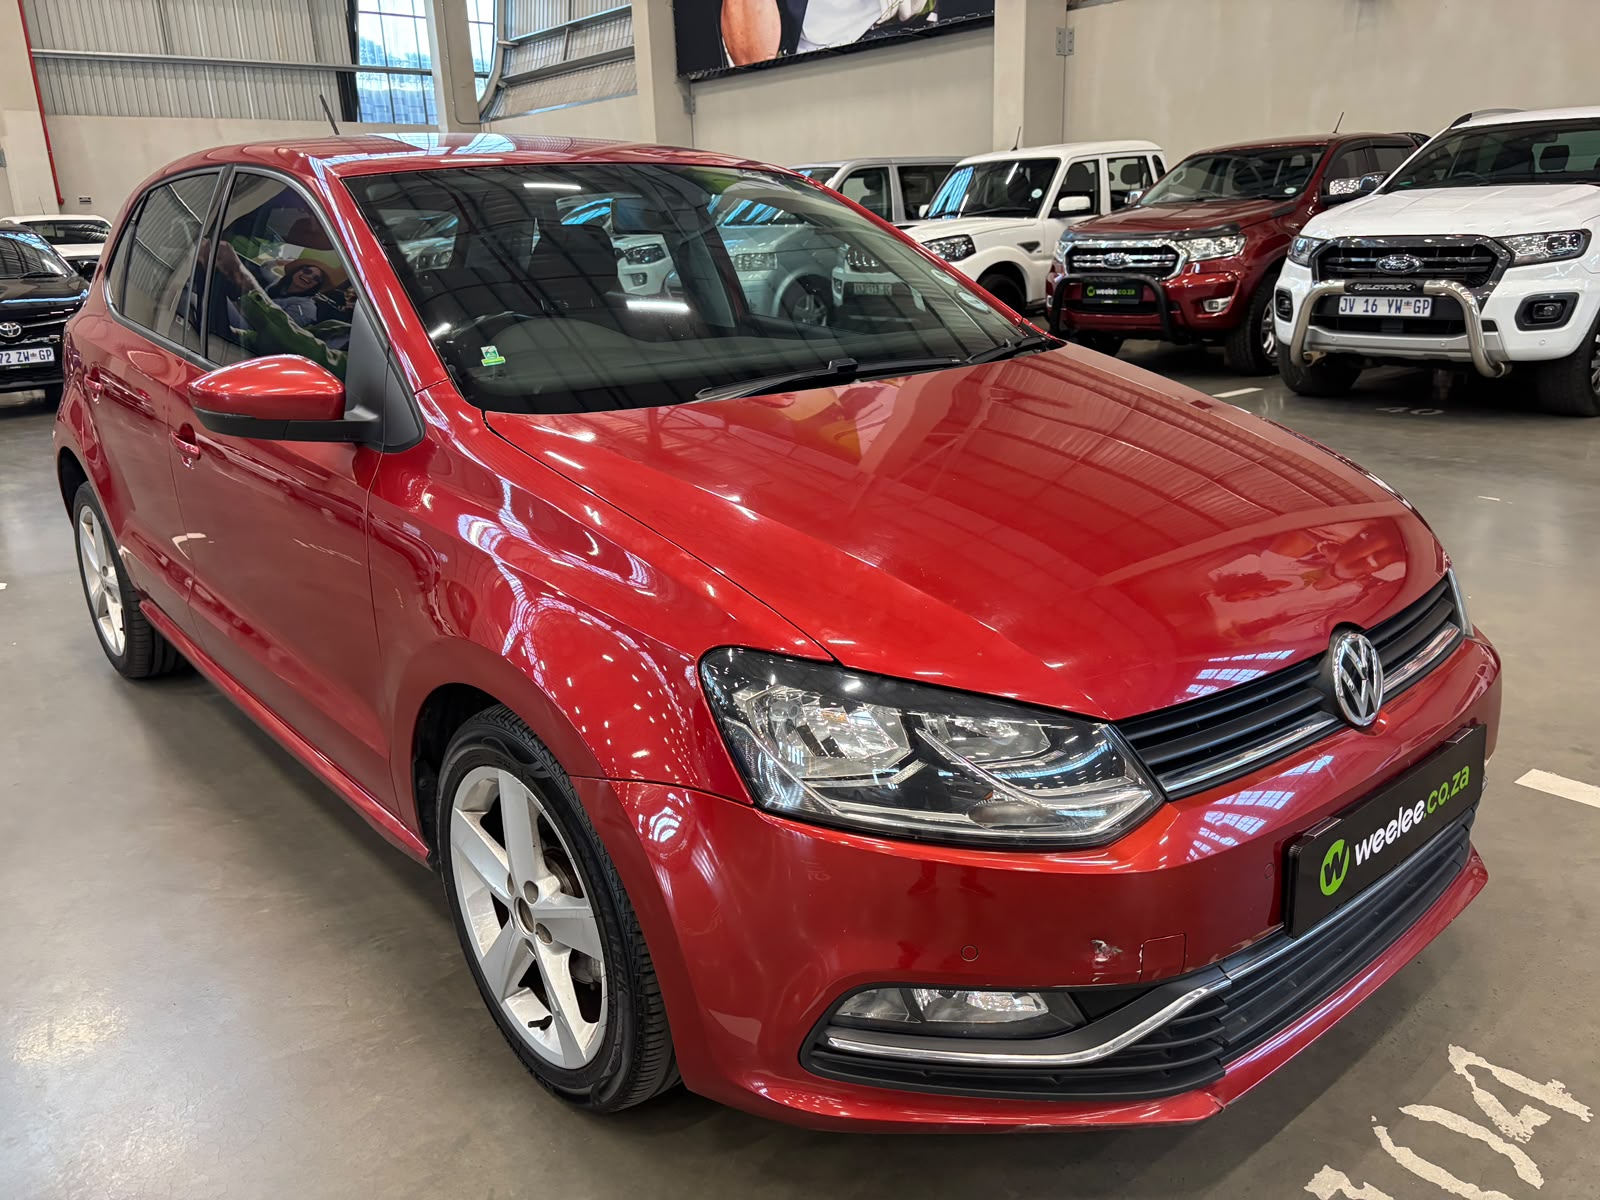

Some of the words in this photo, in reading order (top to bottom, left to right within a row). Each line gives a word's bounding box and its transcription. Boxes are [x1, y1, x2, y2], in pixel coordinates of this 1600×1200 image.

[1340, 298, 1356, 312] JV
[1363, 298, 1378, 313] 16
[1387, 299, 1403, 314] YW
[1413, 299, 1430, 314] GP
[16, 351, 30, 363] ZW
[38, 349, 52, 360] GP
[1354, 765, 1470, 866] weelee.co.za
